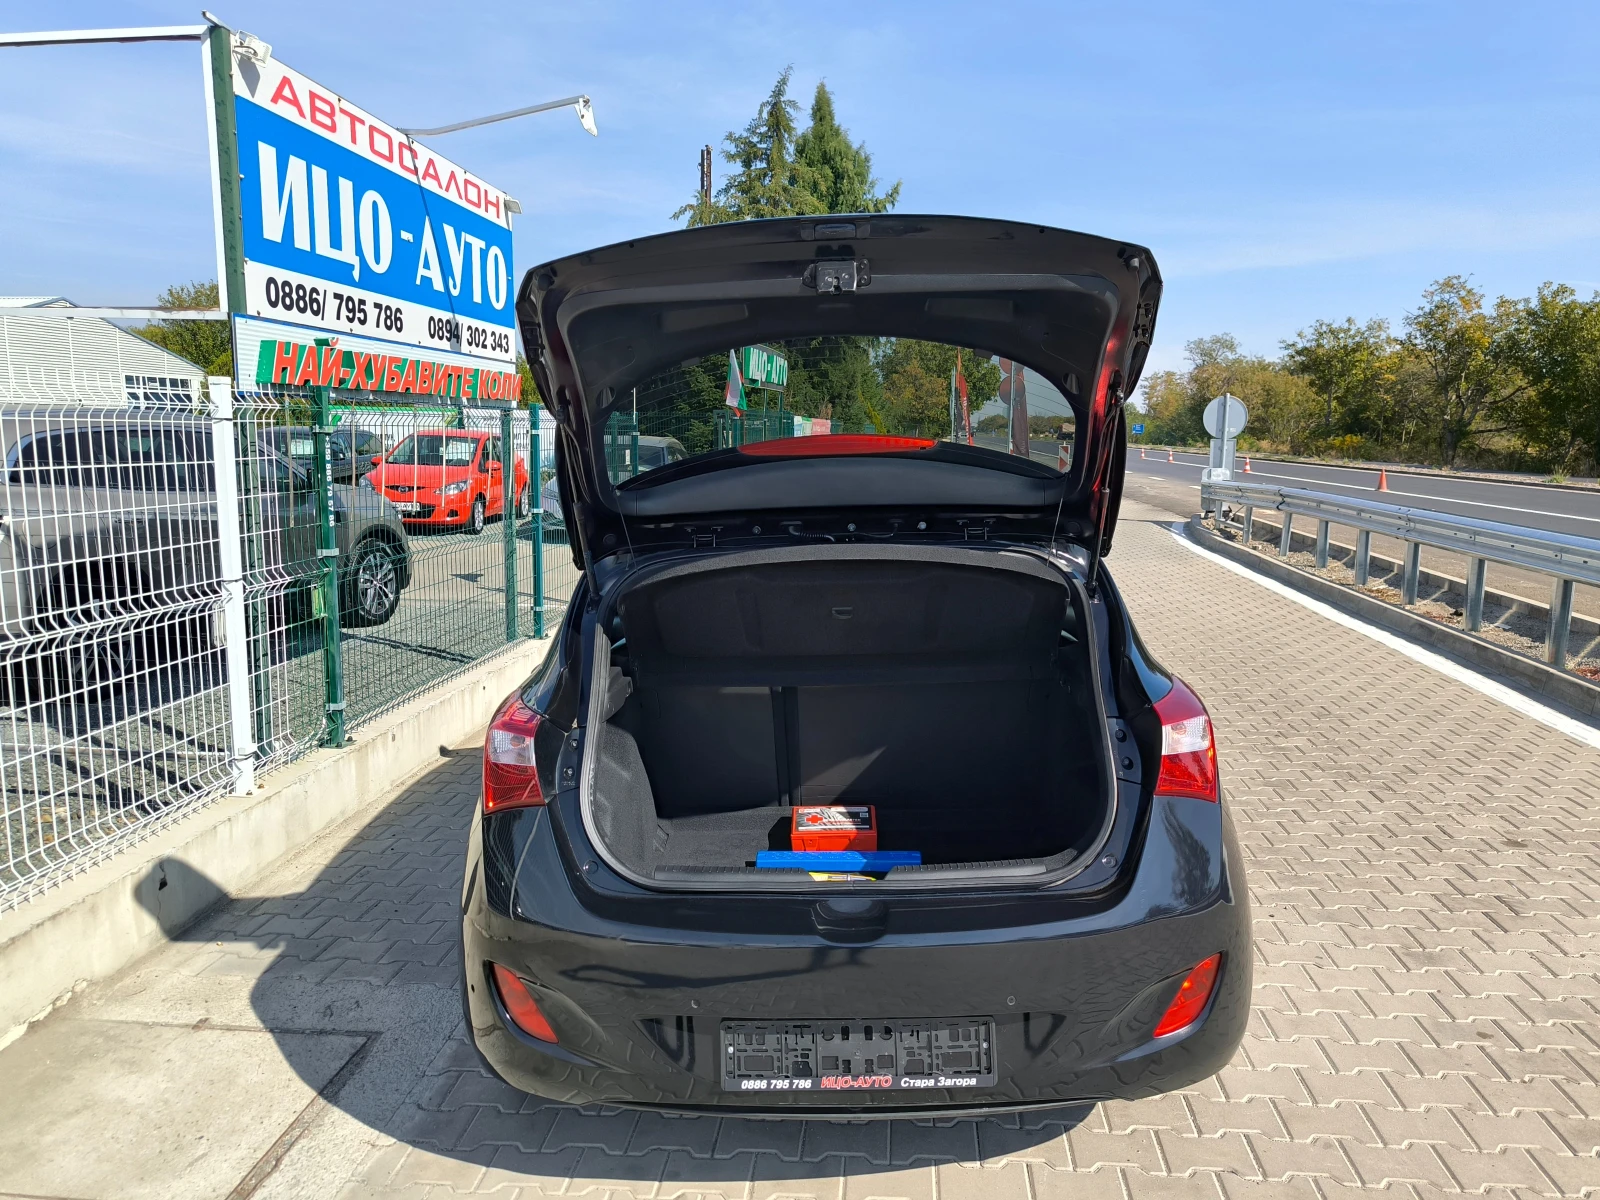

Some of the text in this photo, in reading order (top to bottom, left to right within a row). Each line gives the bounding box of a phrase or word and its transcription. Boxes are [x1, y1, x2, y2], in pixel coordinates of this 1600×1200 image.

[270, 75, 501, 219] АВТОСАЛОН
[257, 140, 508, 310] ИЦО-АУТО
[265, 276, 510, 354] 0886/ 795 786 0894/ 302 343
[272, 337, 521, 400] НАЙ-ХУБАВИТЕ КОЛИ
[741, 1076, 977, 1089] 0886 795 786 ИЦО-АУТО Стара Загора
